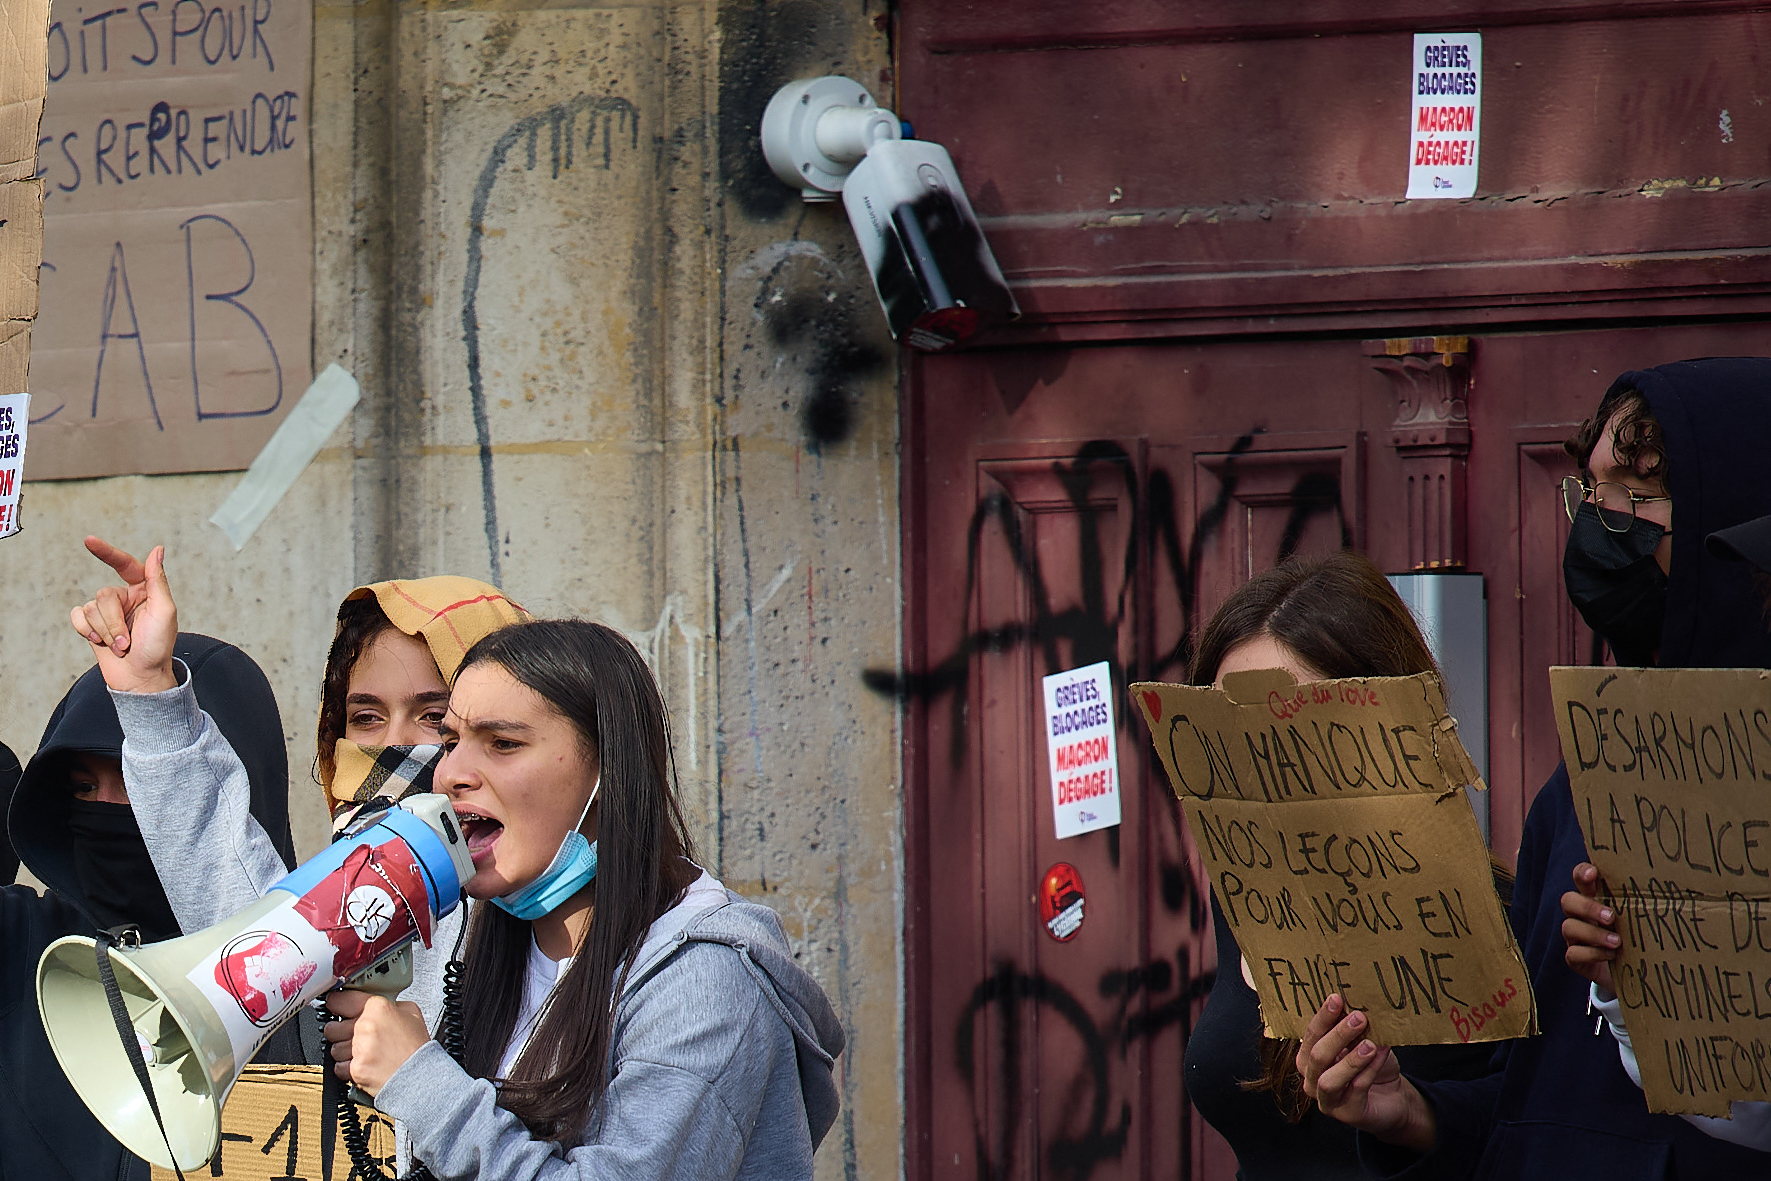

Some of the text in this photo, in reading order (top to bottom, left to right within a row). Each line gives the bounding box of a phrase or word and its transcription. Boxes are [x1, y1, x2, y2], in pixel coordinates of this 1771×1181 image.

[171, 0, 275, 72] POUR
[1425, 38, 1471, 70] GRÈVES,
[1418, 72, 1477, 95] BLOCAGES
[1417, 106, 1475, 132] MACRON
[1052, 702, 1108, 736] BLOCAGES
[1055, 676, 1101, 708] GRÈVES,
[1056, 735, 1109, 773] MACRON
[1168, 714, 1434, 804] ON MANQUE
[1197, 810, 1422, 895] NOS LEÇONS
[1586, 793, 1771, 879] LA POLICE
[1212, 870, 1473, 940] POUR VOUS EN
[1599, 876, 1719, 953] MARRE
[1263, 947, 1470, 1018] FAIRE UNE
